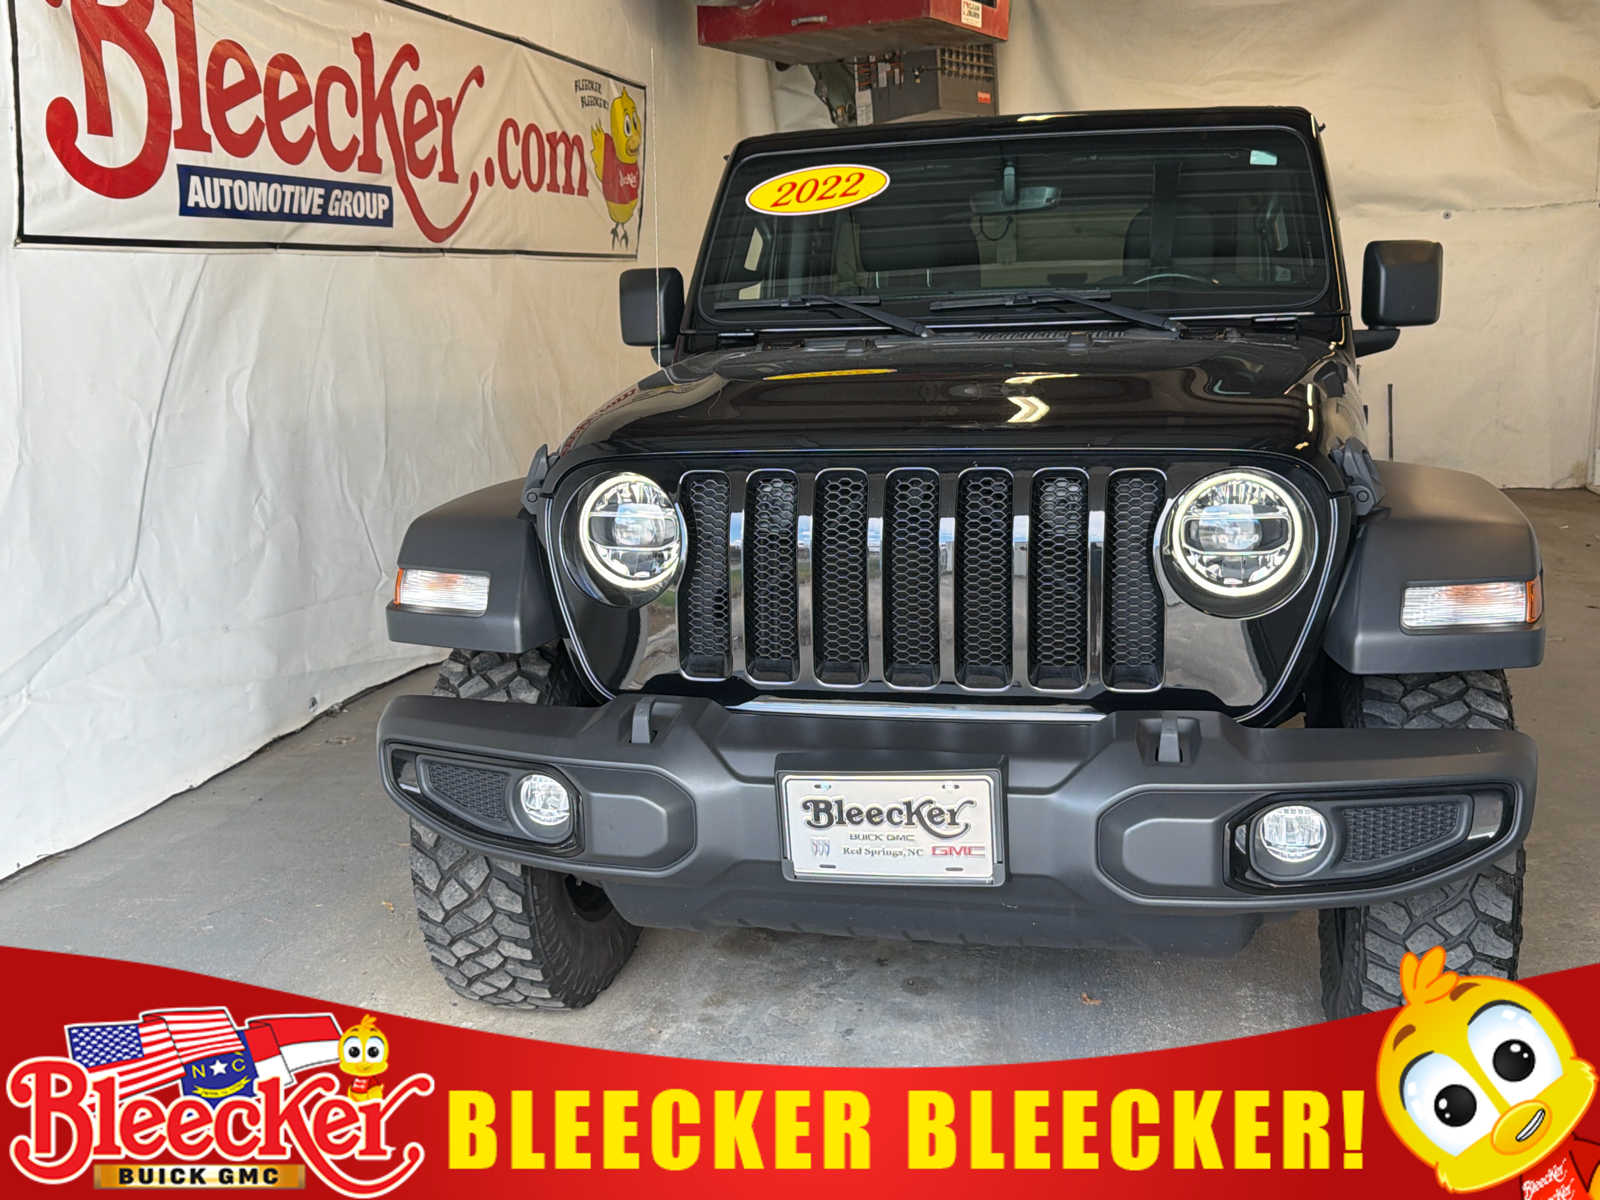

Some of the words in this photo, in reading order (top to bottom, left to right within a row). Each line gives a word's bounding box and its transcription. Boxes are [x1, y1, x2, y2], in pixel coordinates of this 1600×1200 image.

[771, 172, 865, 207] 2022
[187, 175, 325, 216] AUTOMOTIVE
[327, 189, 390, 220] GROUP
[849, 833, 883, 842] BUICK
[886, 834, 916, 842] GMC
[843, 847, 862, 856] Red
[907, 848, 925, 857] NC
[931, 846, 986, 857] GMC
